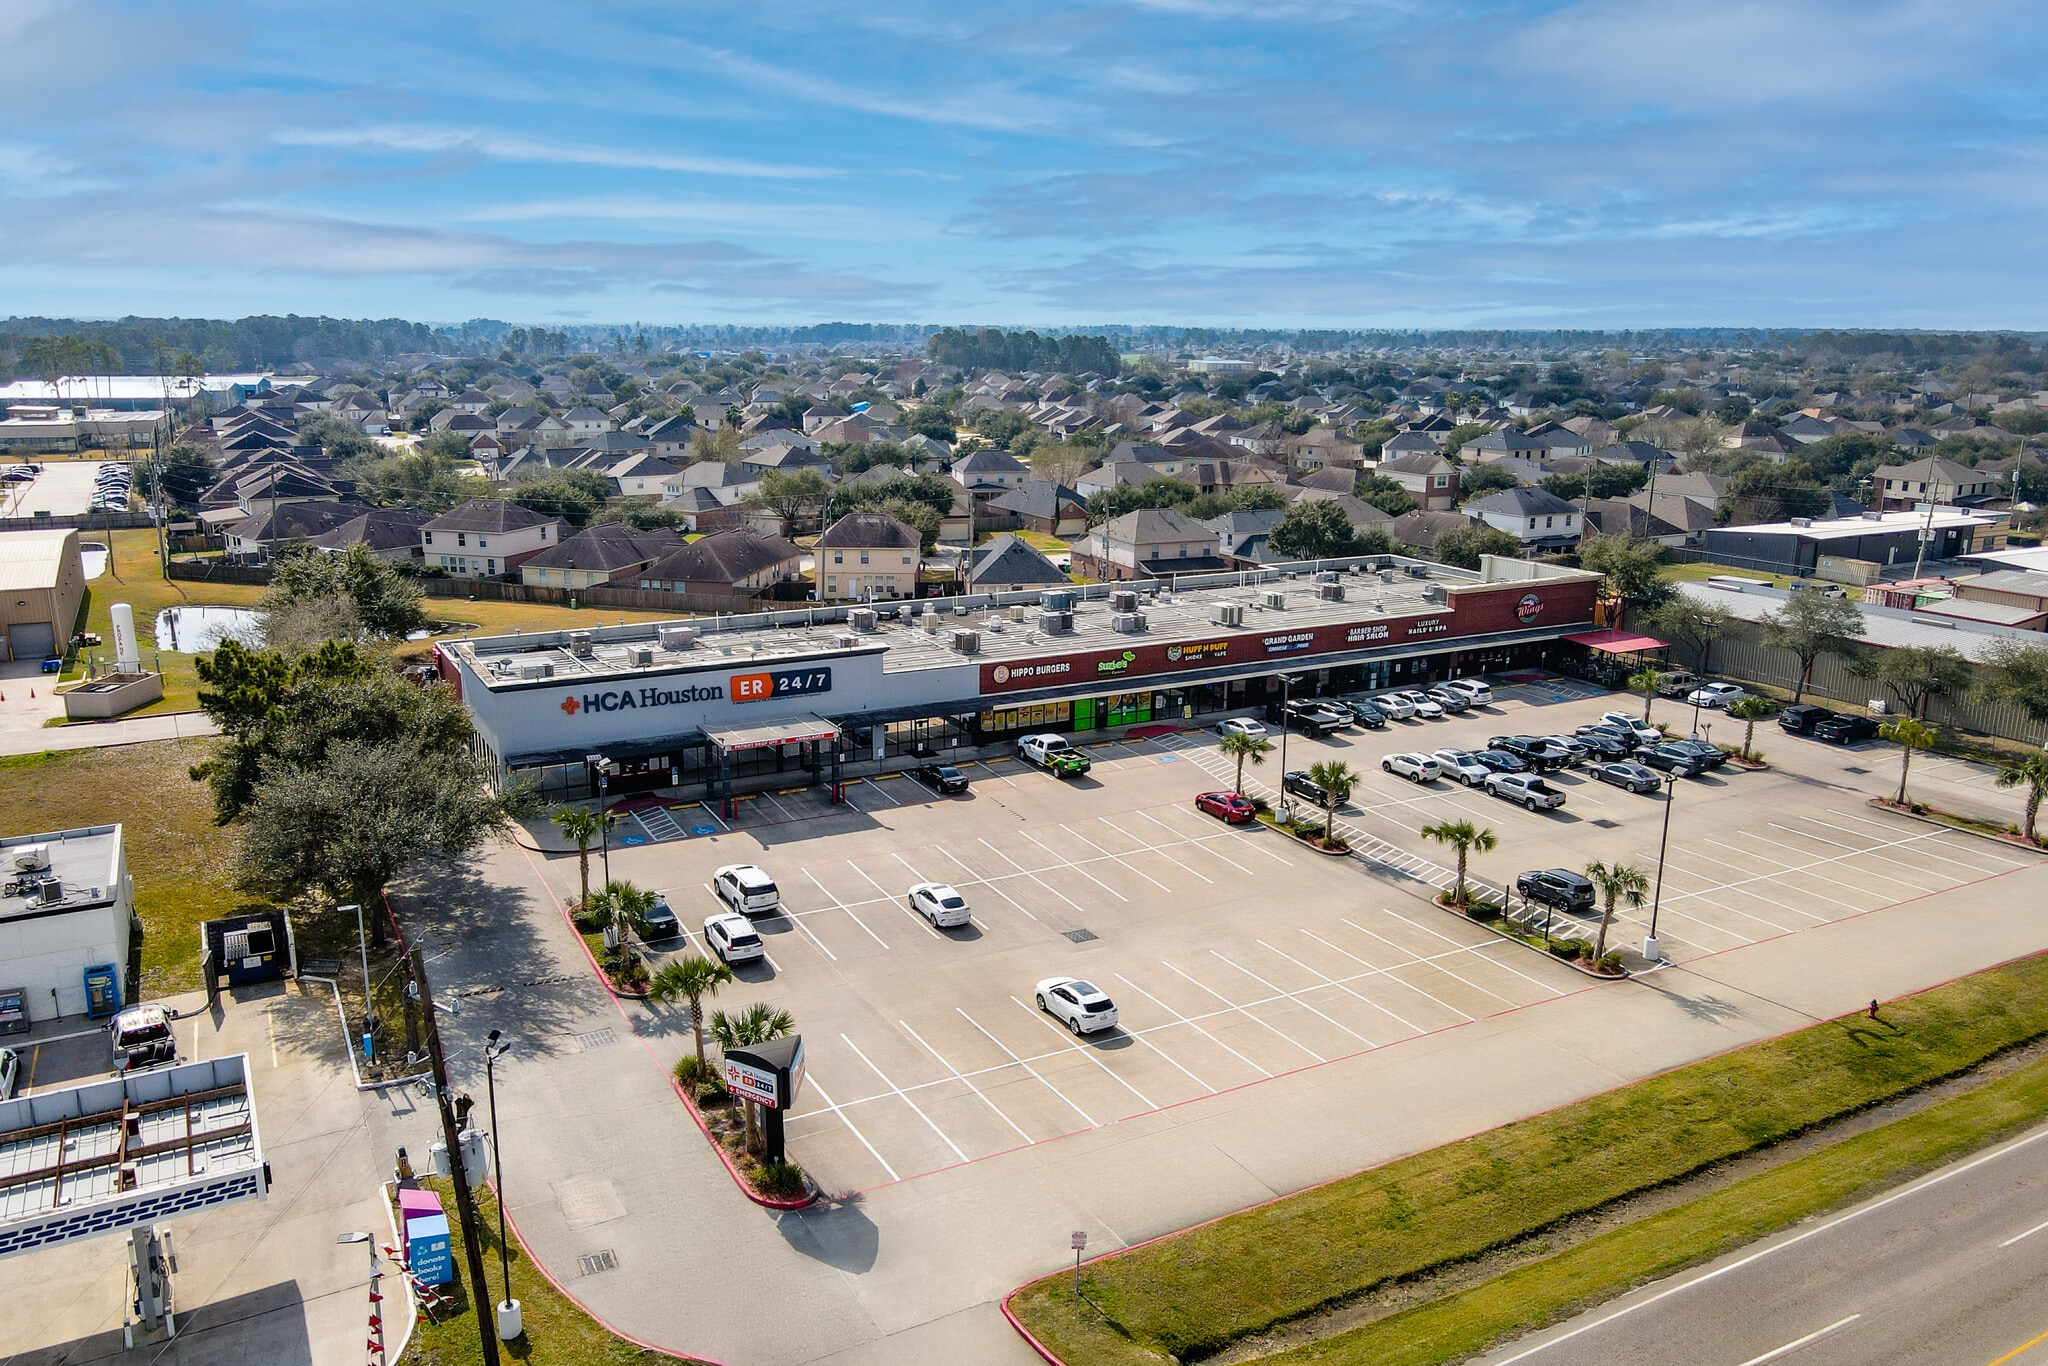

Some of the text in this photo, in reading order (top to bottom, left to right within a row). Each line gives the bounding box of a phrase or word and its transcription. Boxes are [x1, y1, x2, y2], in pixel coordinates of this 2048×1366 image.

[1517, 603, 1544, 617] Wings
[1417, 619, 1440, 628] LUXURY
[1350, 624, 1388, 636] BARBER SHOP
[1264, 632, 1314, 646] GRAND GARDEN
[1348, 632, 1389, 642] HAIR SALON
[1183, 645, 1202, 654] HUFF
[1210, 642, 1228, 651] PUFF
[1011, 662, 1070, 678] HIPPO BURGERS
[583, 673, 826, 713] HCA Houston ER 24/7
[742, 1069, 753, 1077] HCA
[744, 1077, 752, 1085] ER
[756, 1082, 772, 1092] 24/7
[736, 1088, 773, 1106] EMERGENCY
[417, 1255, 446, 1266] donate
[418, 1264, 442, 1275] books
[419, 1272, 440, 1283] here!
